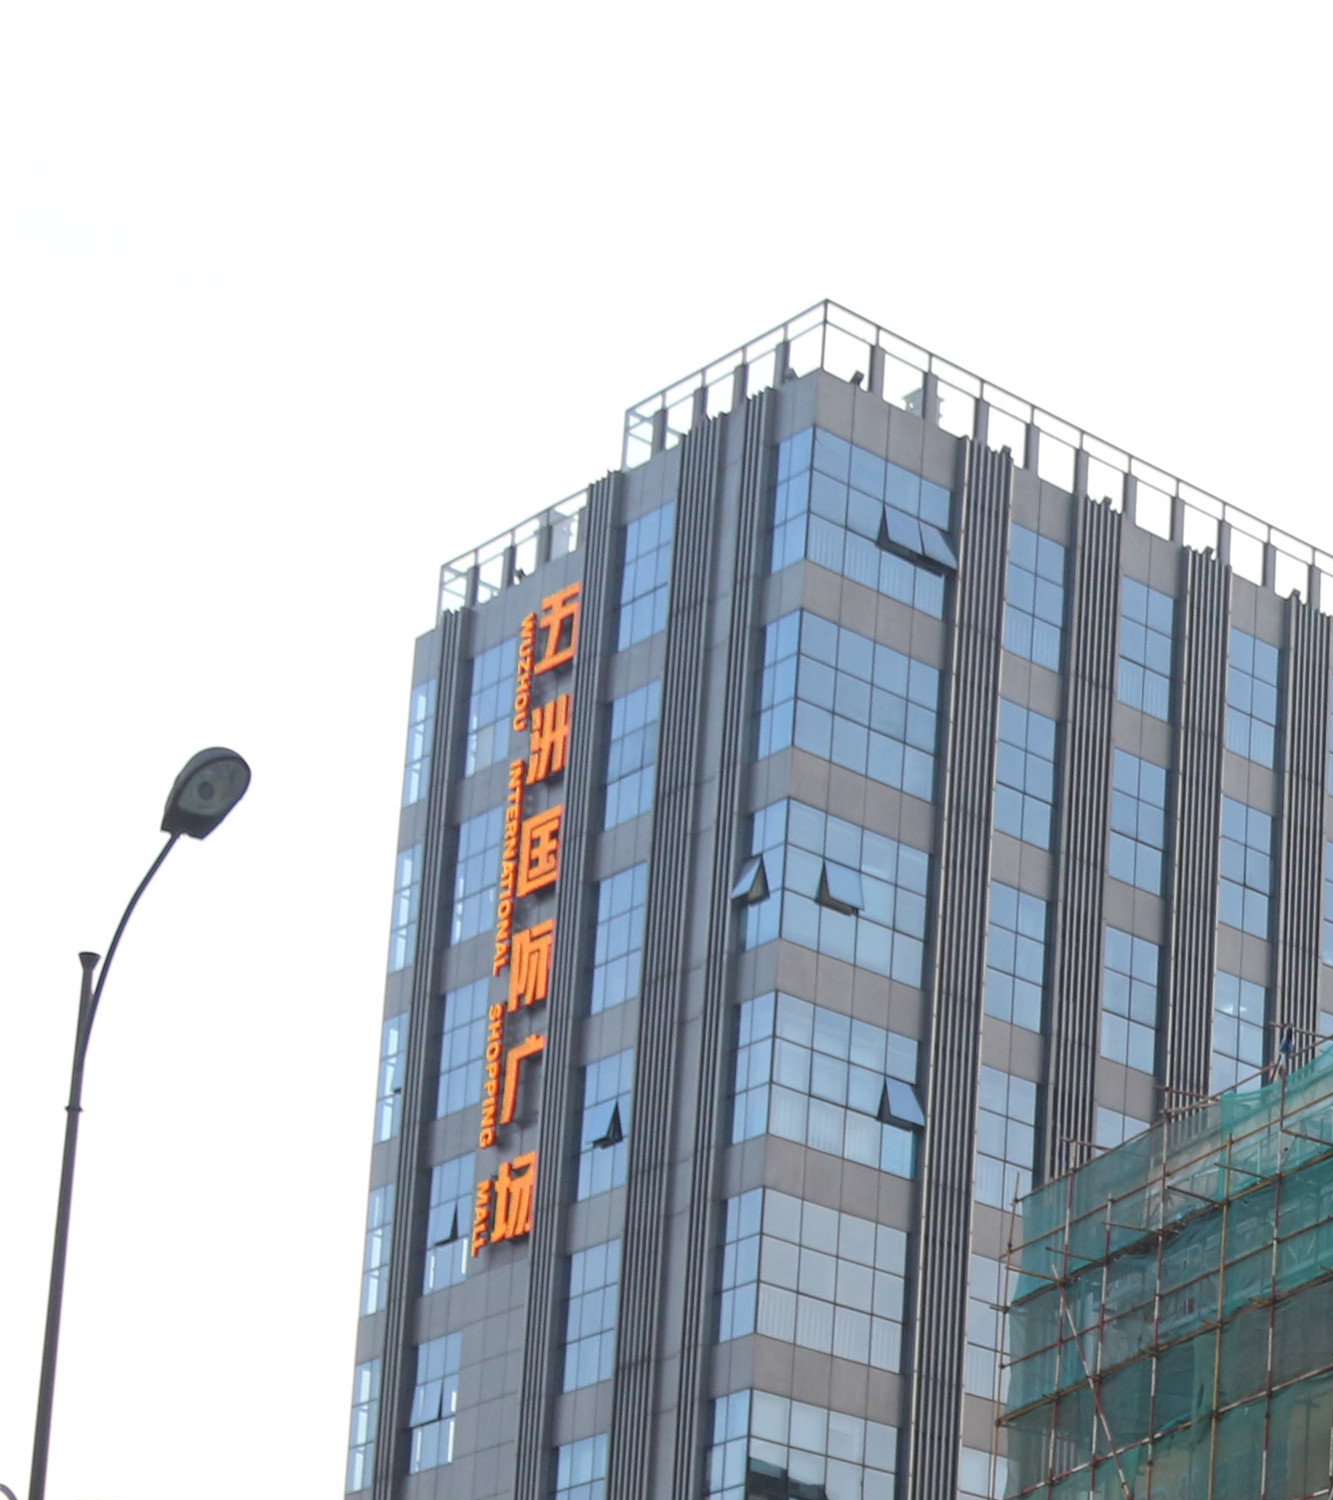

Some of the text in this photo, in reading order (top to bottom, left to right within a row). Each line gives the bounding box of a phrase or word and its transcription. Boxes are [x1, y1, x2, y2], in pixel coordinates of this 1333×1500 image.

[470, 612, 537, 1258] WUZHOU INTERNATIONAL SHOPPING MALL
[490, 581, 582, 1245] 五洲国际广场
